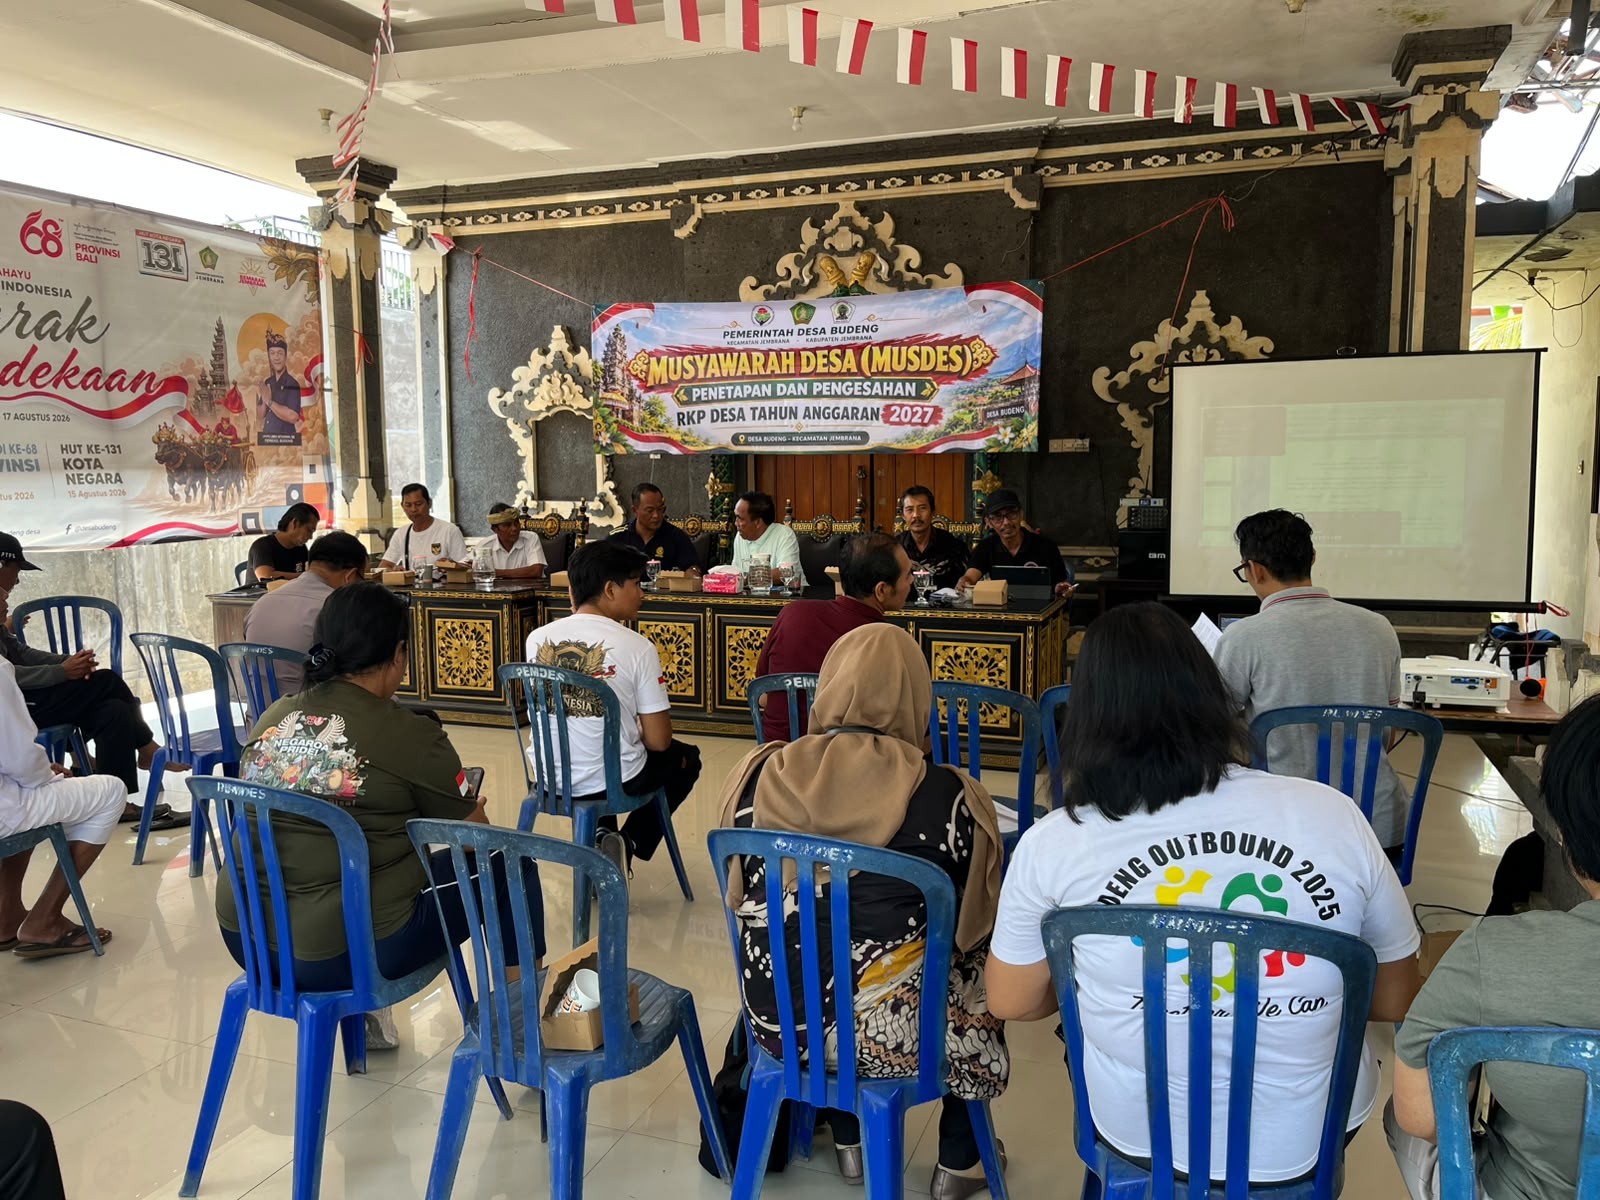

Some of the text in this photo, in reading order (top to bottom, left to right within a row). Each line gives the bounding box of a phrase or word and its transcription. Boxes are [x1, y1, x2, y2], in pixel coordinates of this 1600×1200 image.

[20, 209, 63, 258] 68
[75, 243, 120, 258] PROVINSI
[76, 252, 98, 264] BALI
[0, 268, 31, 280] HAYU
[1, 281, 73, 299] INDONESIA
[0, 295, 110, 344] rak
[722, 324, 879, 340] PEMERINTAH DESA BUDENG
[0, 343, 164, 395] dekaan
[646, 344, 973, 387] MUSYAWARAH DESA (MUSDES)
[692, 381, 917, 402] PENETAPAN DAN PENGESAHAN
[2, 413, 71, 422] 17 AGUSTUS 2026
[676, 406, 935, 427] RKP DESA TAHUN ANGGARAN 2027
[986, 406, 1025, 419] DESA BUDENG
[763, 435, 787, 443] BUDENG
[829, 434, 862, 442] JEMBRANA
[9, 444, 38, 455] KE-68
[60, 444, 122, 455] HUT KE-131
[63, 458, 104, 470] KOTA
[65, 472, 123, 485] NEGARA
[14, 491, 34, 500] 2026
[68, 488, 127, 499] 15 Agustus 2026
[784, 676, 819, 688] PEM
[1147, 830, 1294, 869] OUTBOUND
[1290, 860, 1342, 921] 2025
[1288, 995, 1329, 1015] Can
